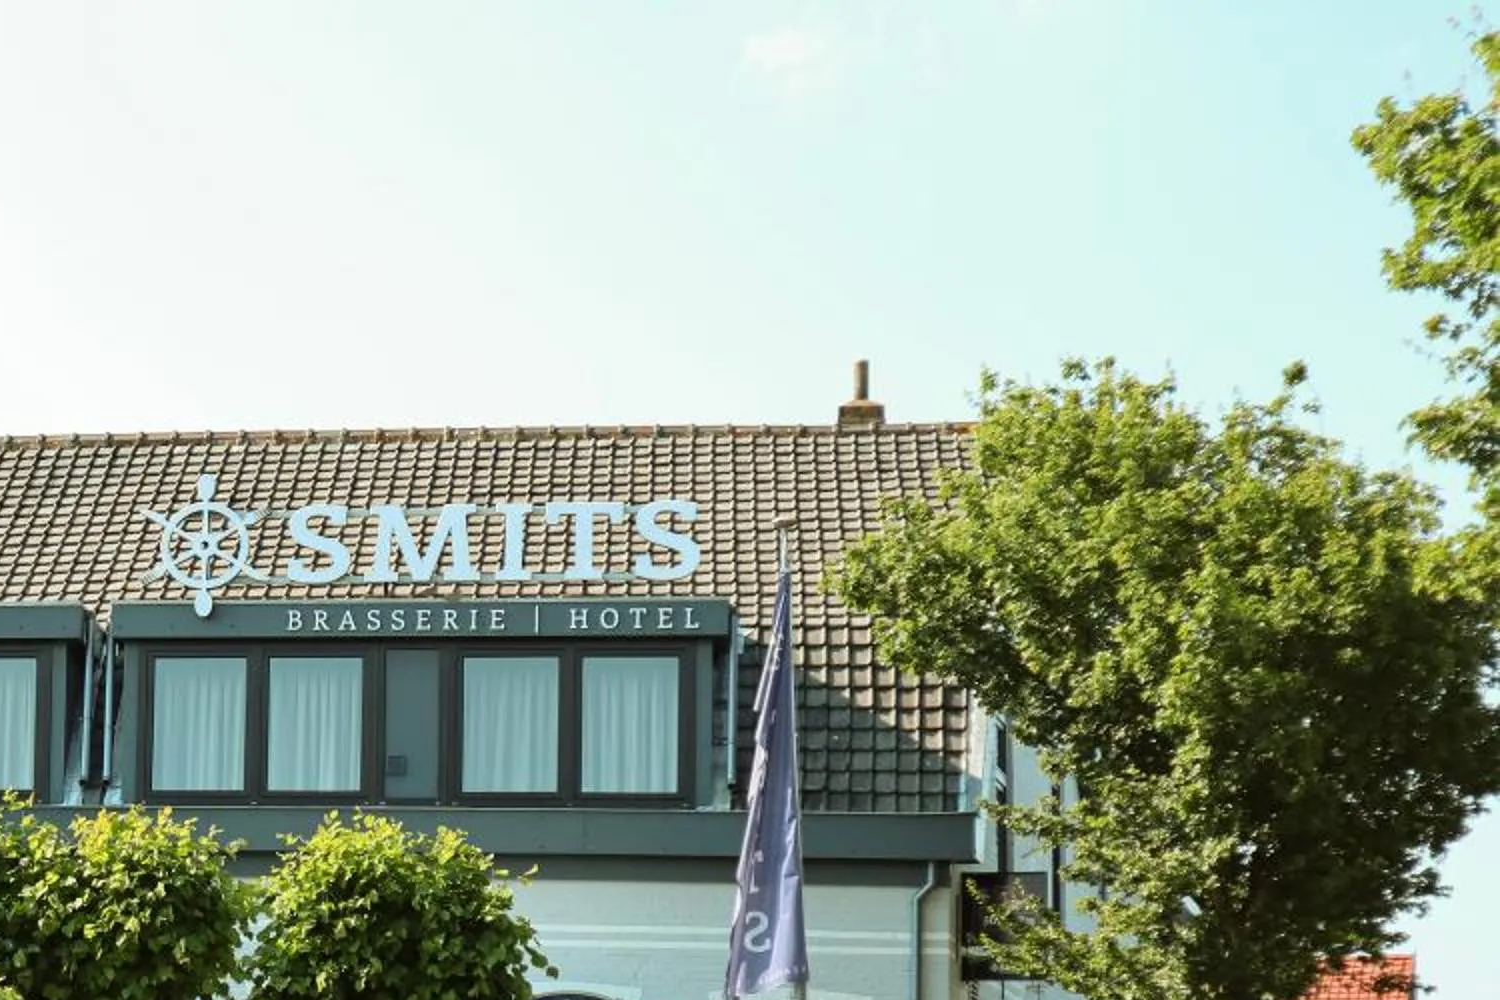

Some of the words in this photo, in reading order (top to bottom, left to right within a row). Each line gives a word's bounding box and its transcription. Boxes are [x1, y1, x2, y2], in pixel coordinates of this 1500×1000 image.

[287, 499, 701, 584] SMITS
[287, 608, 507, 632] BRASSERIE
[570, 606, 702, 631] HOTEL
